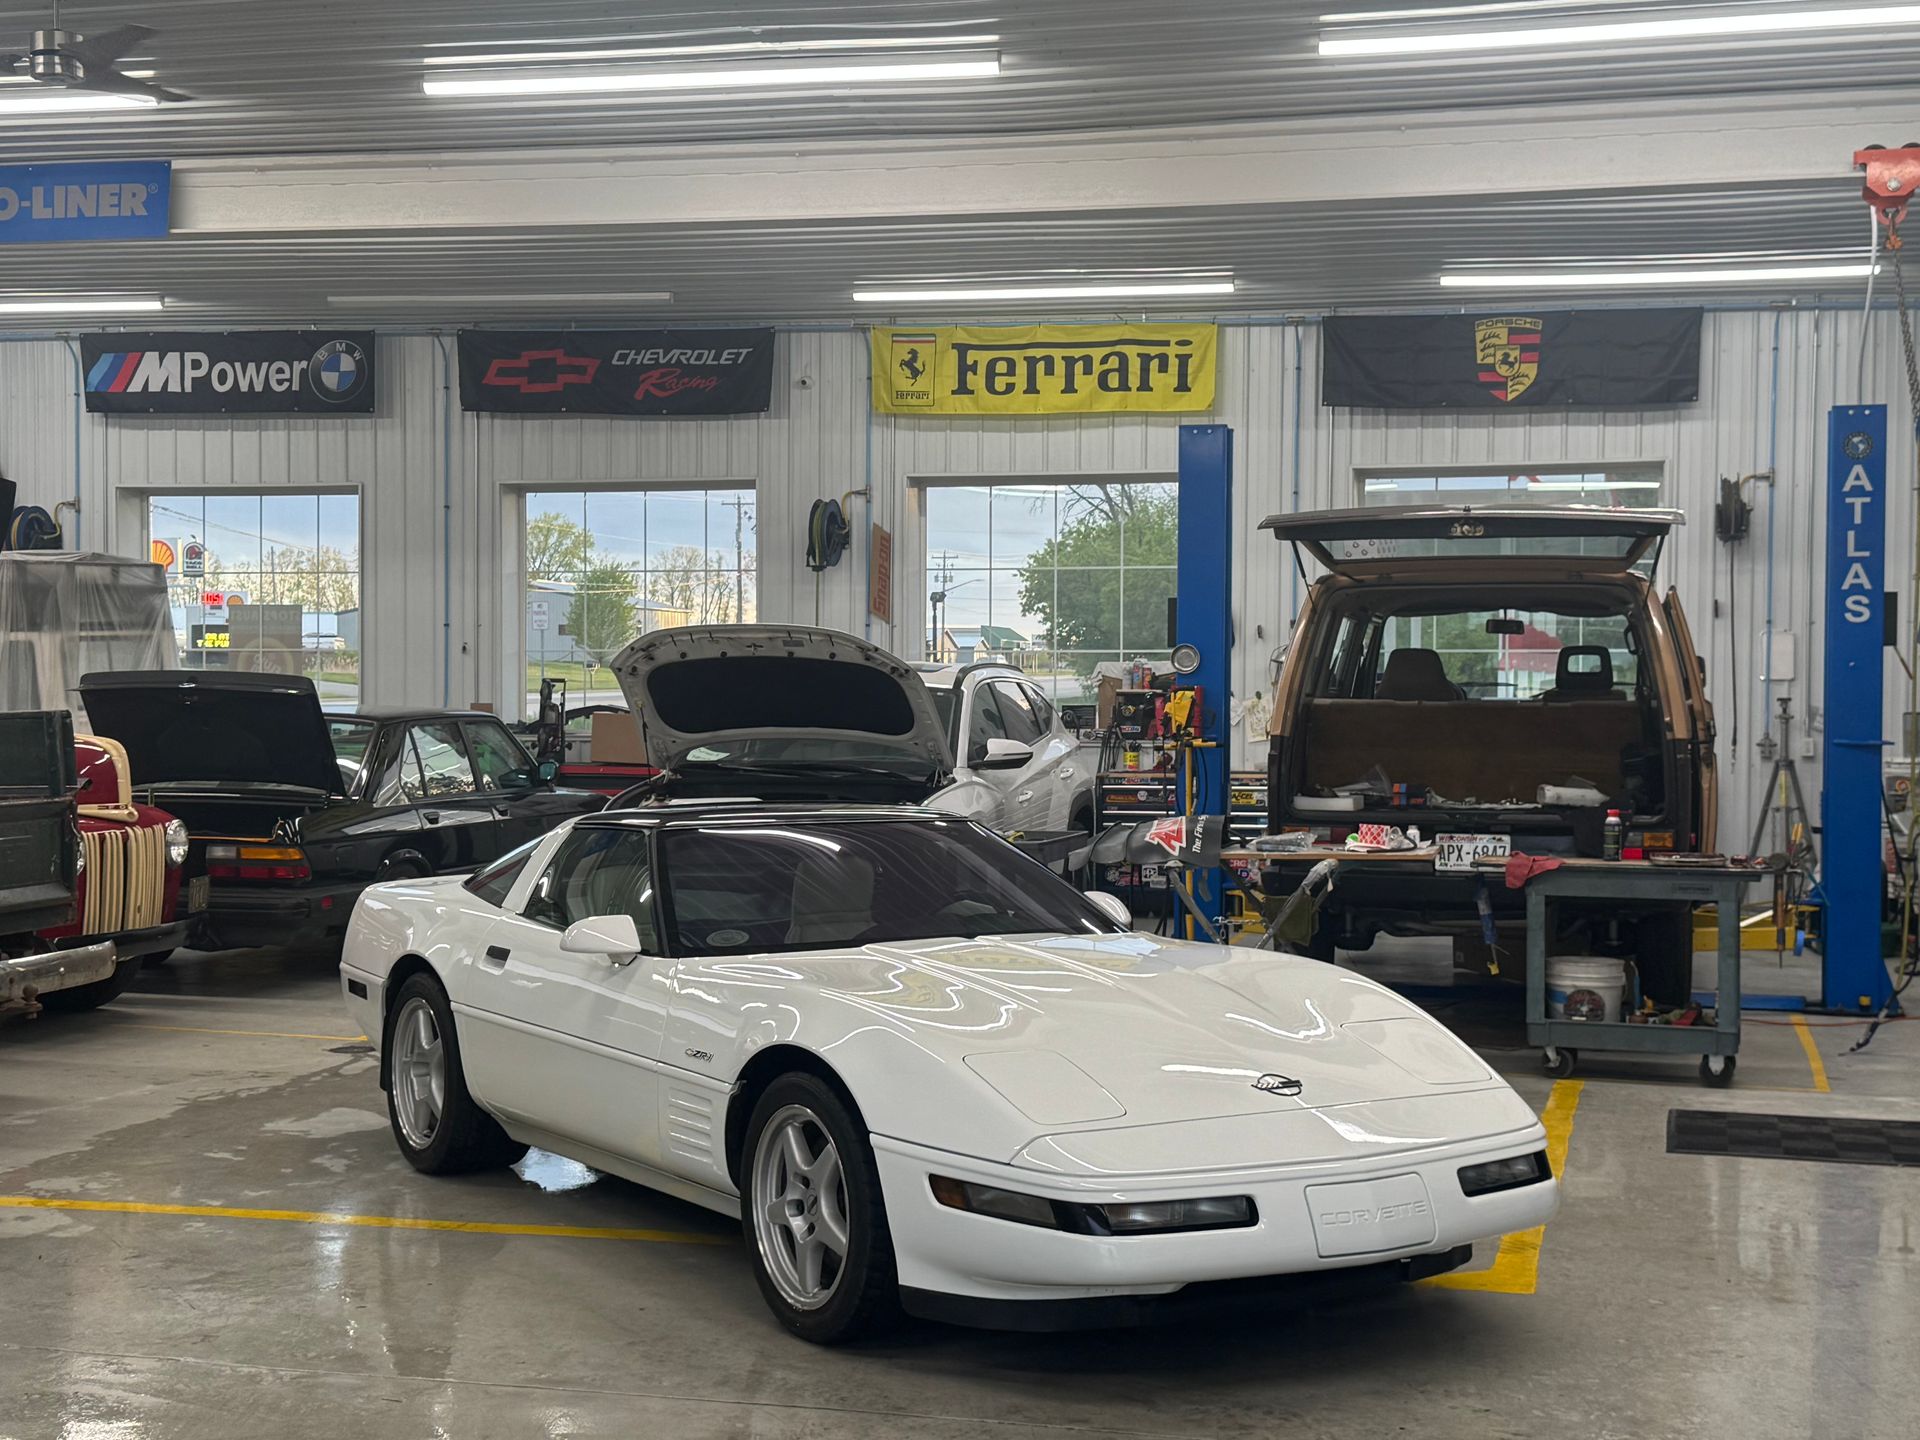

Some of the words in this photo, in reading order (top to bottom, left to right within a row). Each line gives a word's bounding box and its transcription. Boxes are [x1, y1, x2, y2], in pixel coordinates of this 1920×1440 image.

[1476, 318, 1541, 329] PORSCHE
[317, 342, 363, 361] BMW
[611, 348, 754, 366] CHEVROLET
[951, 338, 1194, 396] Ferrari
[633, 368, 721, 401] Racing
[895, 390, 931, 400] Ferrari
[1841, 464, 1874, 623] ATLAS
[1320, 1200, 1428, 1227] CORVETTE
